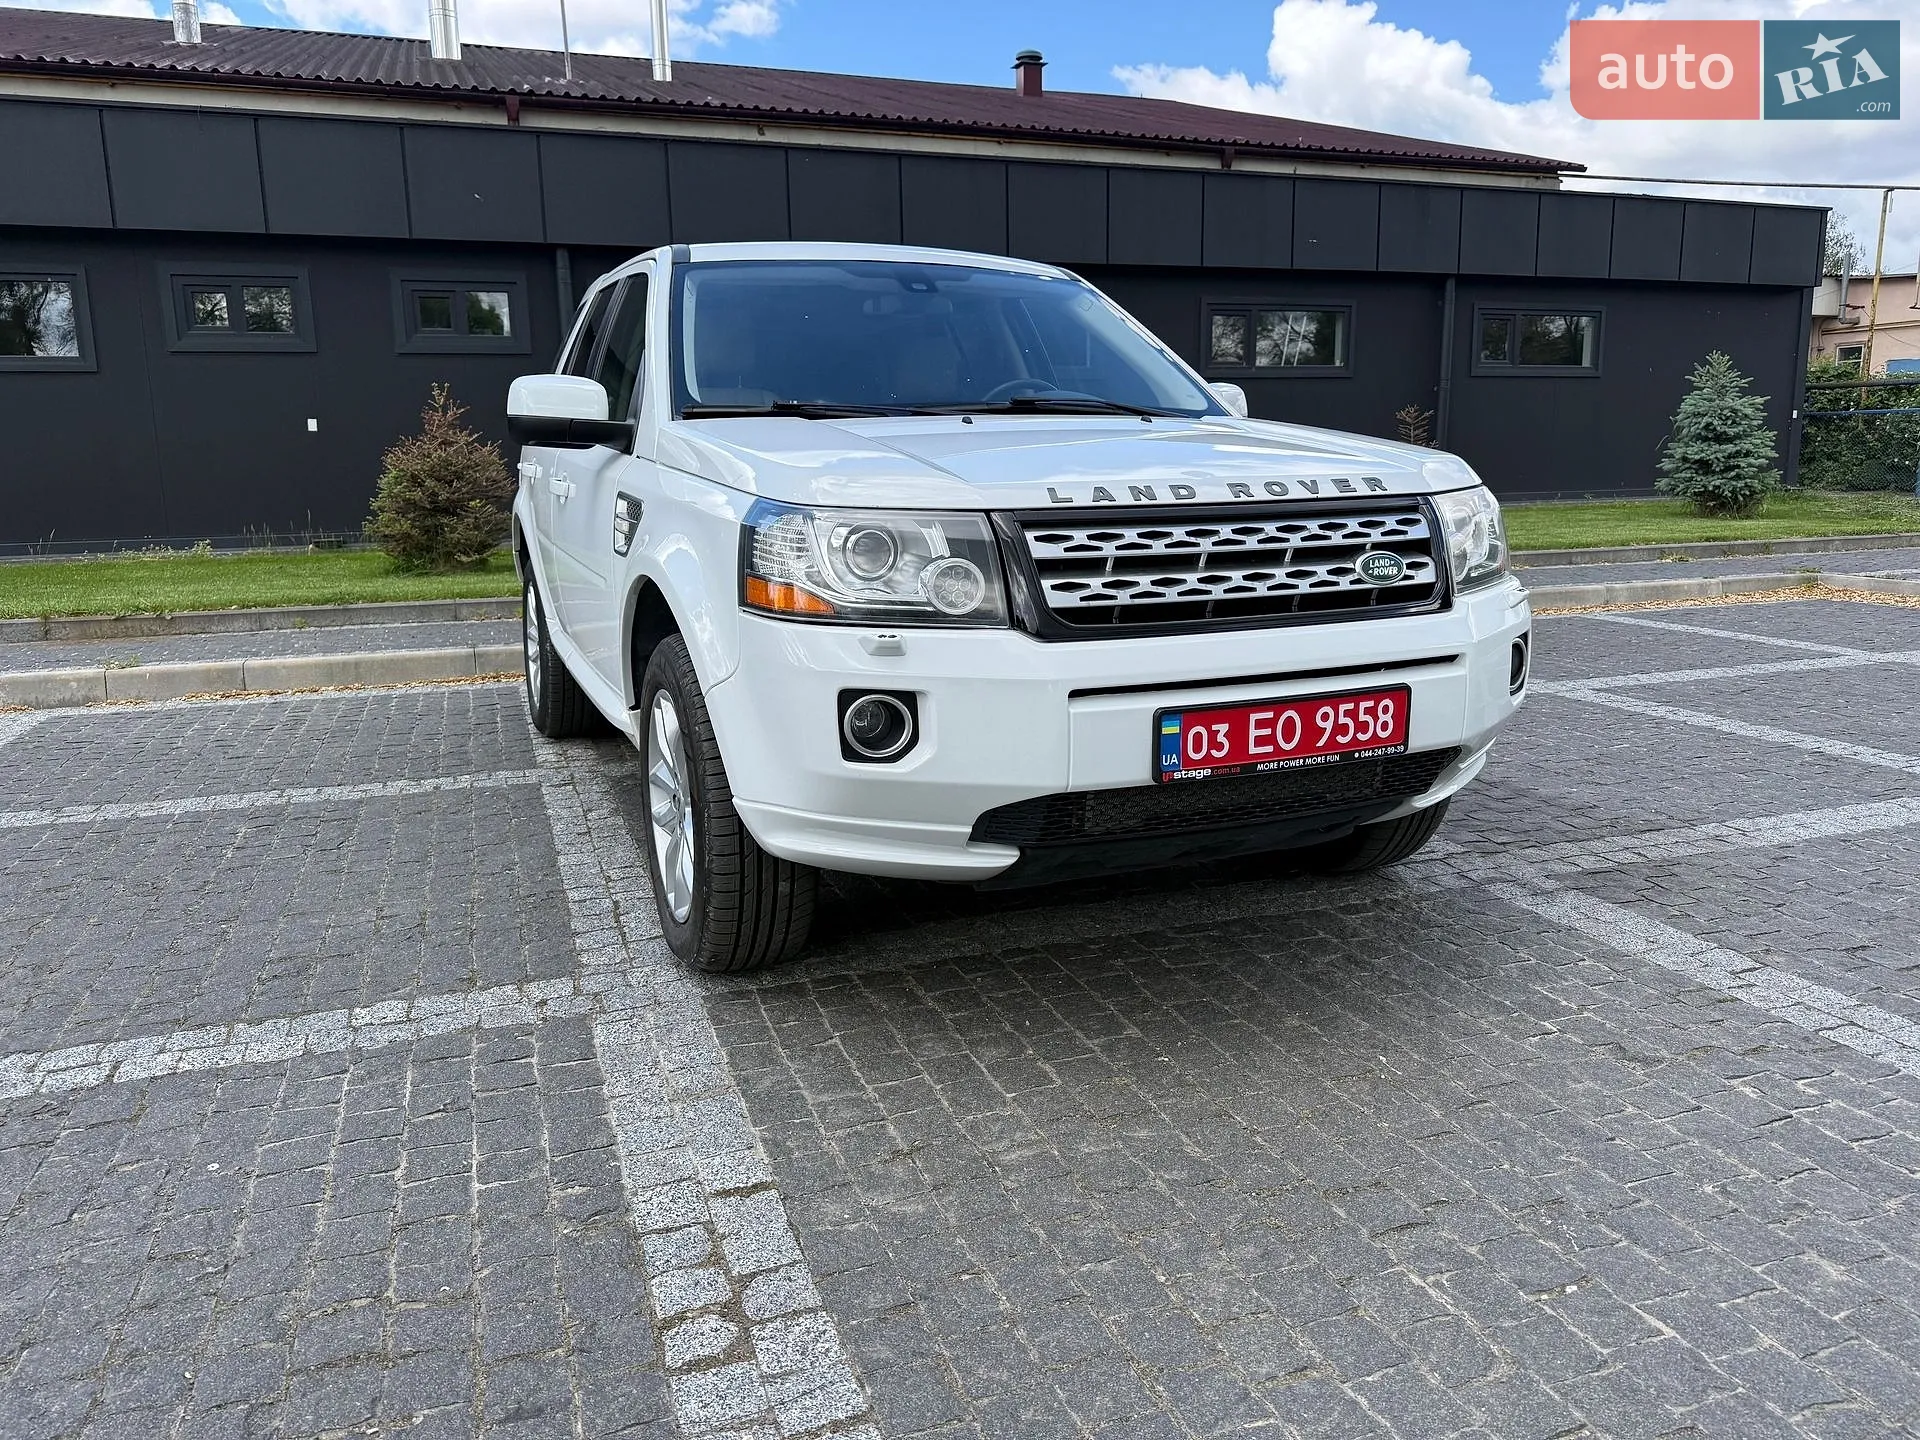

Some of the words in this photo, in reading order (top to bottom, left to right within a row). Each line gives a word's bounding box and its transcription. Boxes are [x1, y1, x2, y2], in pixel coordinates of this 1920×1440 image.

[1046, 483, 1197, 504] LAND
[1226, 475, 1389, 499] ROVER
[1369, 558, 1390, 568] LAND
[1373, 566, 1399, 576] ROVER
[1187, 723, 1230, 760] 03
[1248, 709, 1302, 755] EO
[1315, 698, 1395, 747] 9558
[1162, 753, 1179, 766] UA
[1257, 761, 1278, 771] MORE
[1280, 759, 1304, 767] POWER
[1305, 756, 1326, 765] MORE
[1326, 754, 1340, 762] FUN
